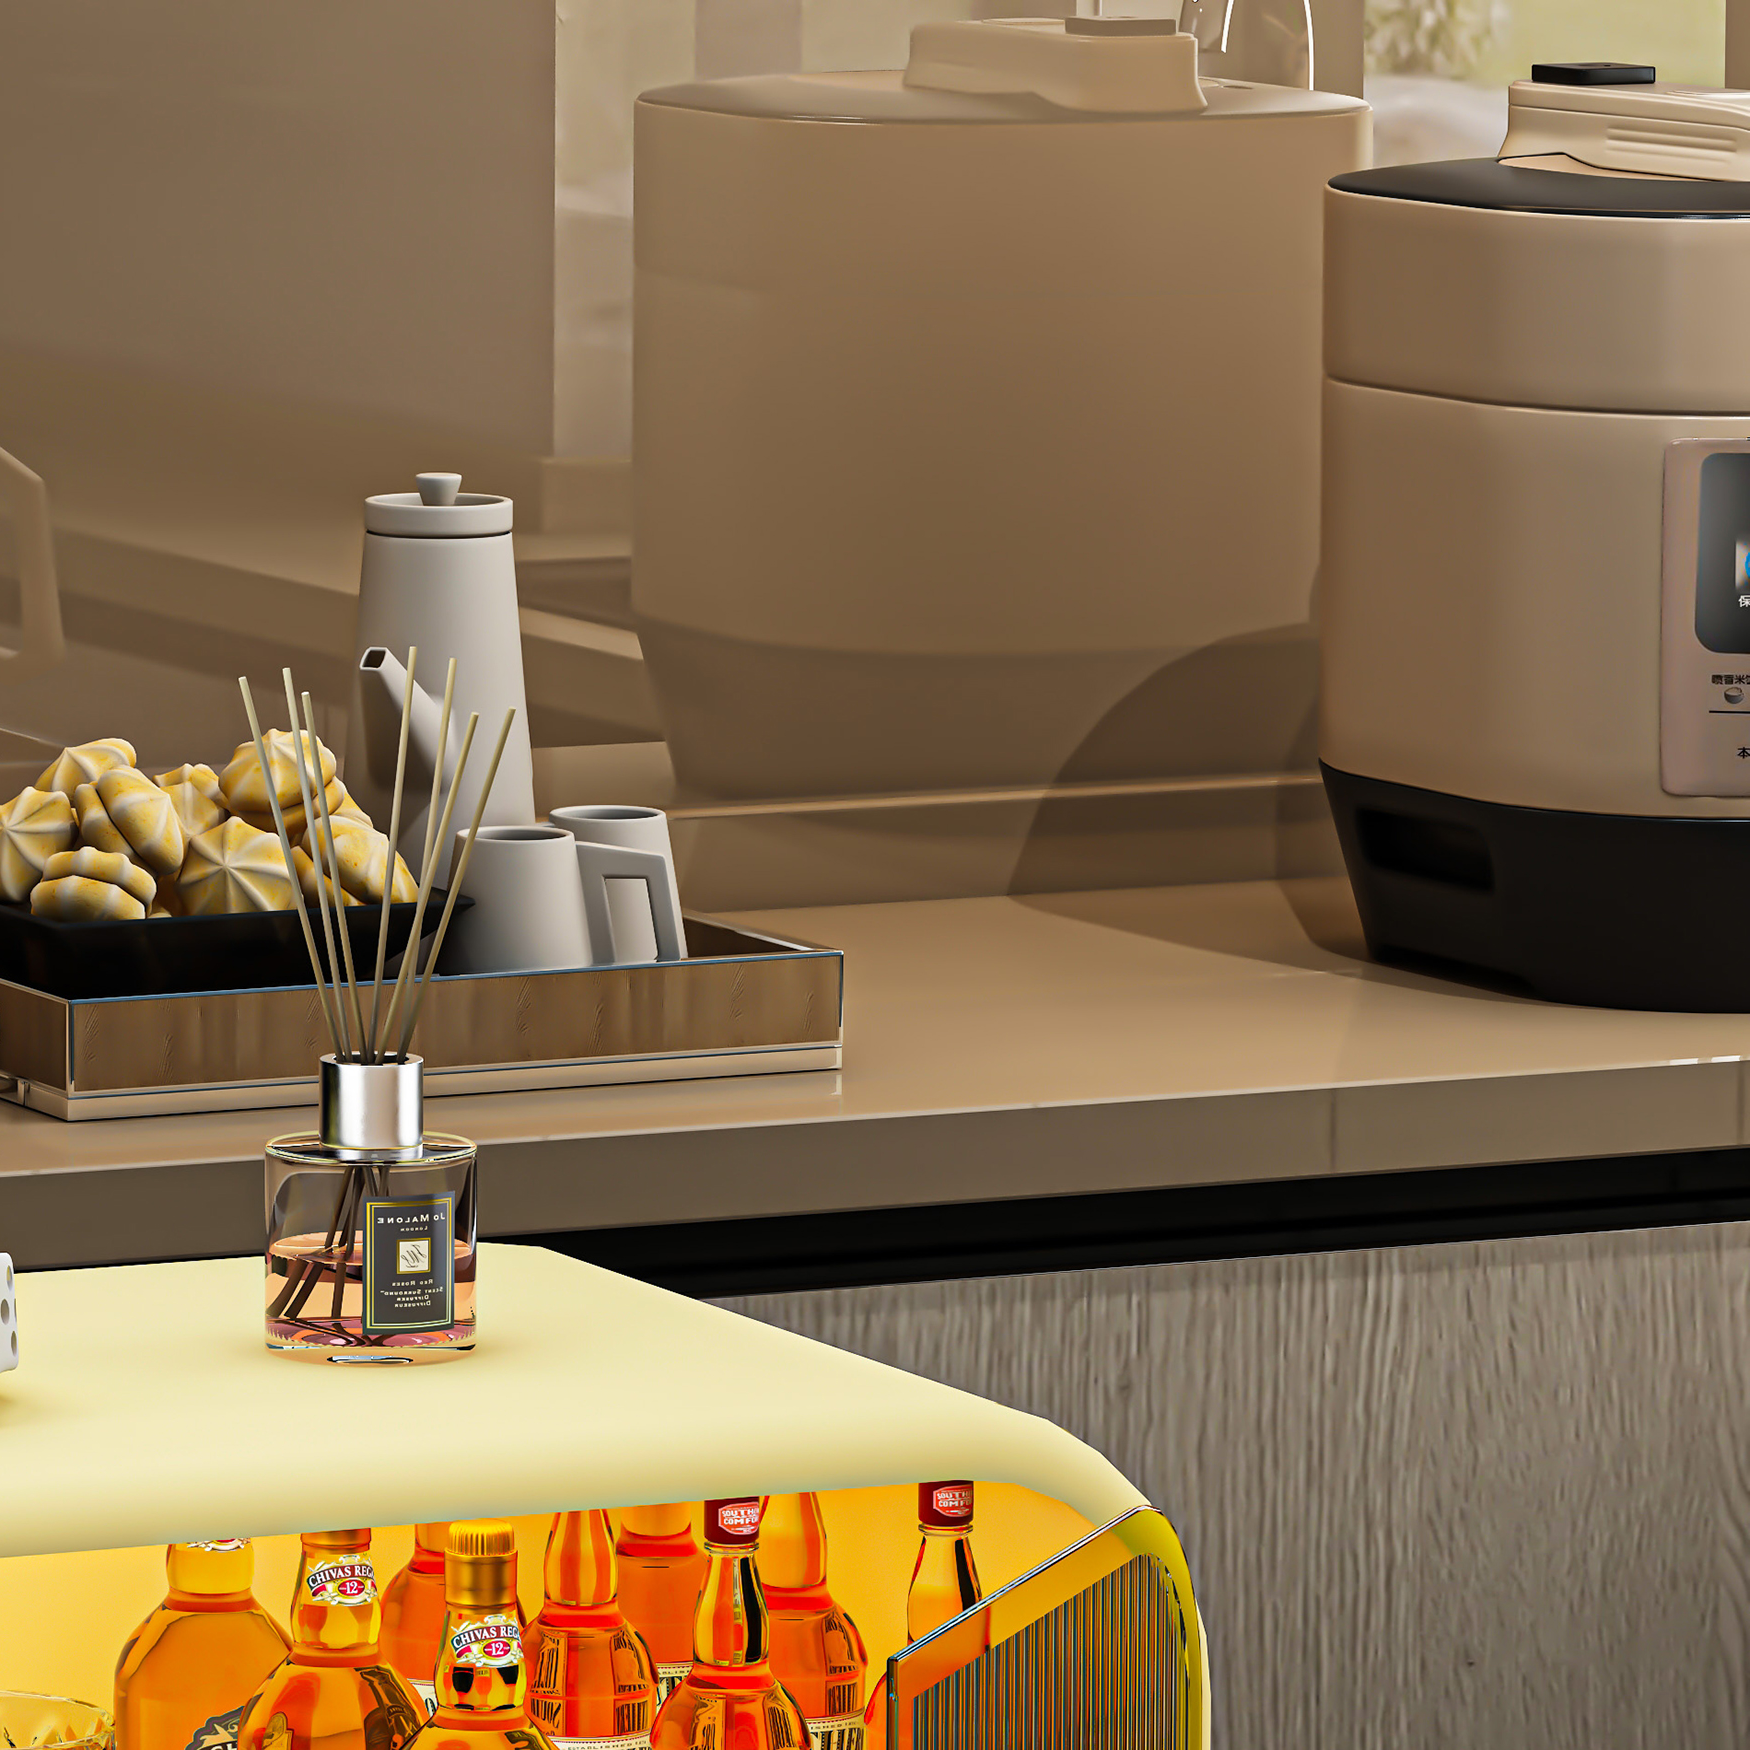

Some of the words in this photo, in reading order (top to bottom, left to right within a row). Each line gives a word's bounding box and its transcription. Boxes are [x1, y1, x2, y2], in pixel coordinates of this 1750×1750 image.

[309, 1567, 351, 1587] CHIVAS
[346, 1581, 358, 1594] 12
[453, 1627, 497, 1648] CHIVAS
[491, 1642, 504, 1655] 12
